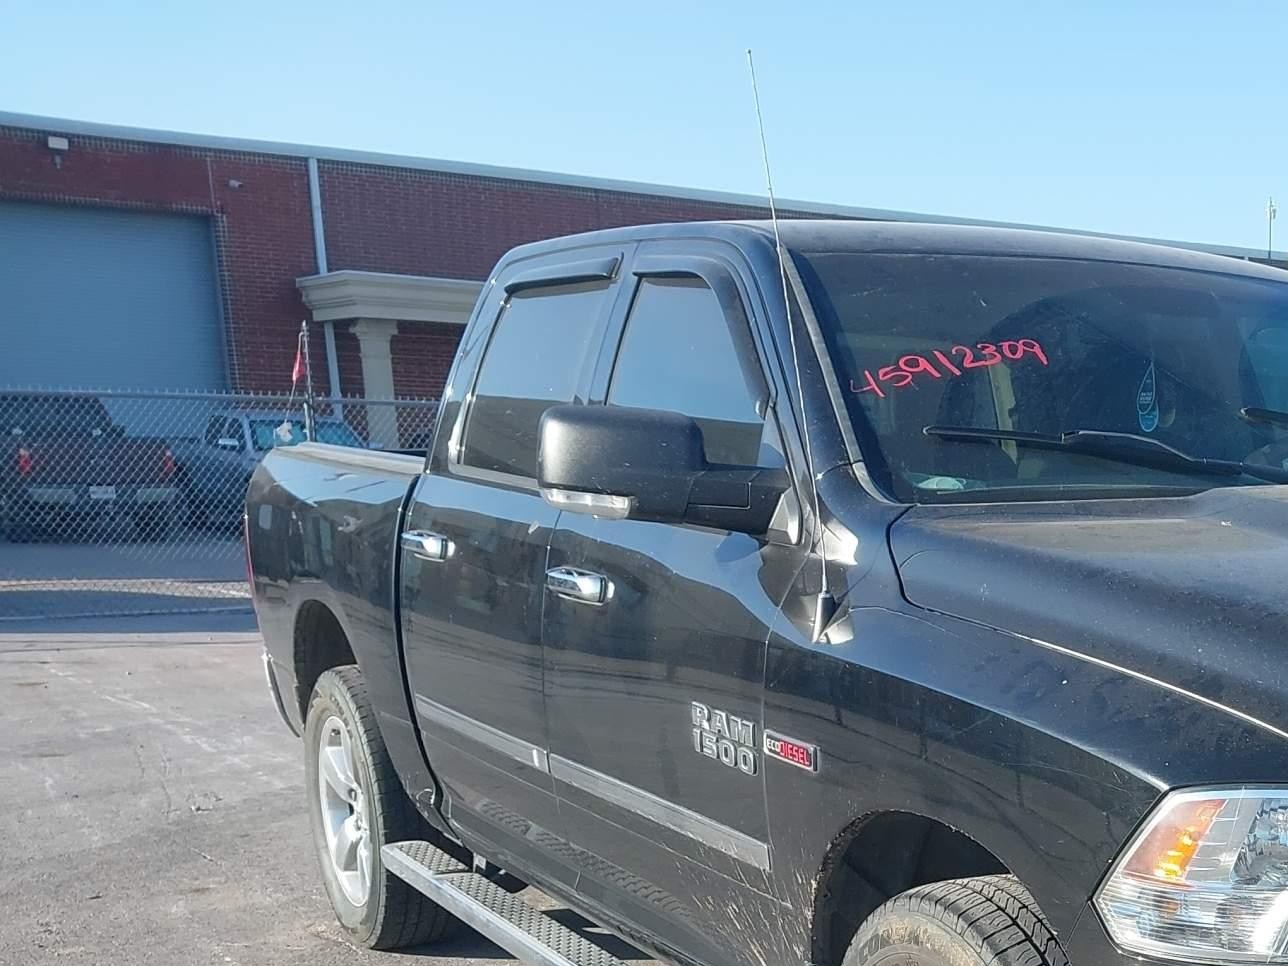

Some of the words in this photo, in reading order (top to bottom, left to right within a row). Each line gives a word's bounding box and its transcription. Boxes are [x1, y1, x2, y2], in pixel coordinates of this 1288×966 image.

[849, 338, 1048, 398] 45912309
[690, 700, 756, 748] RAM
[692, 727, 758, 776] 1500
